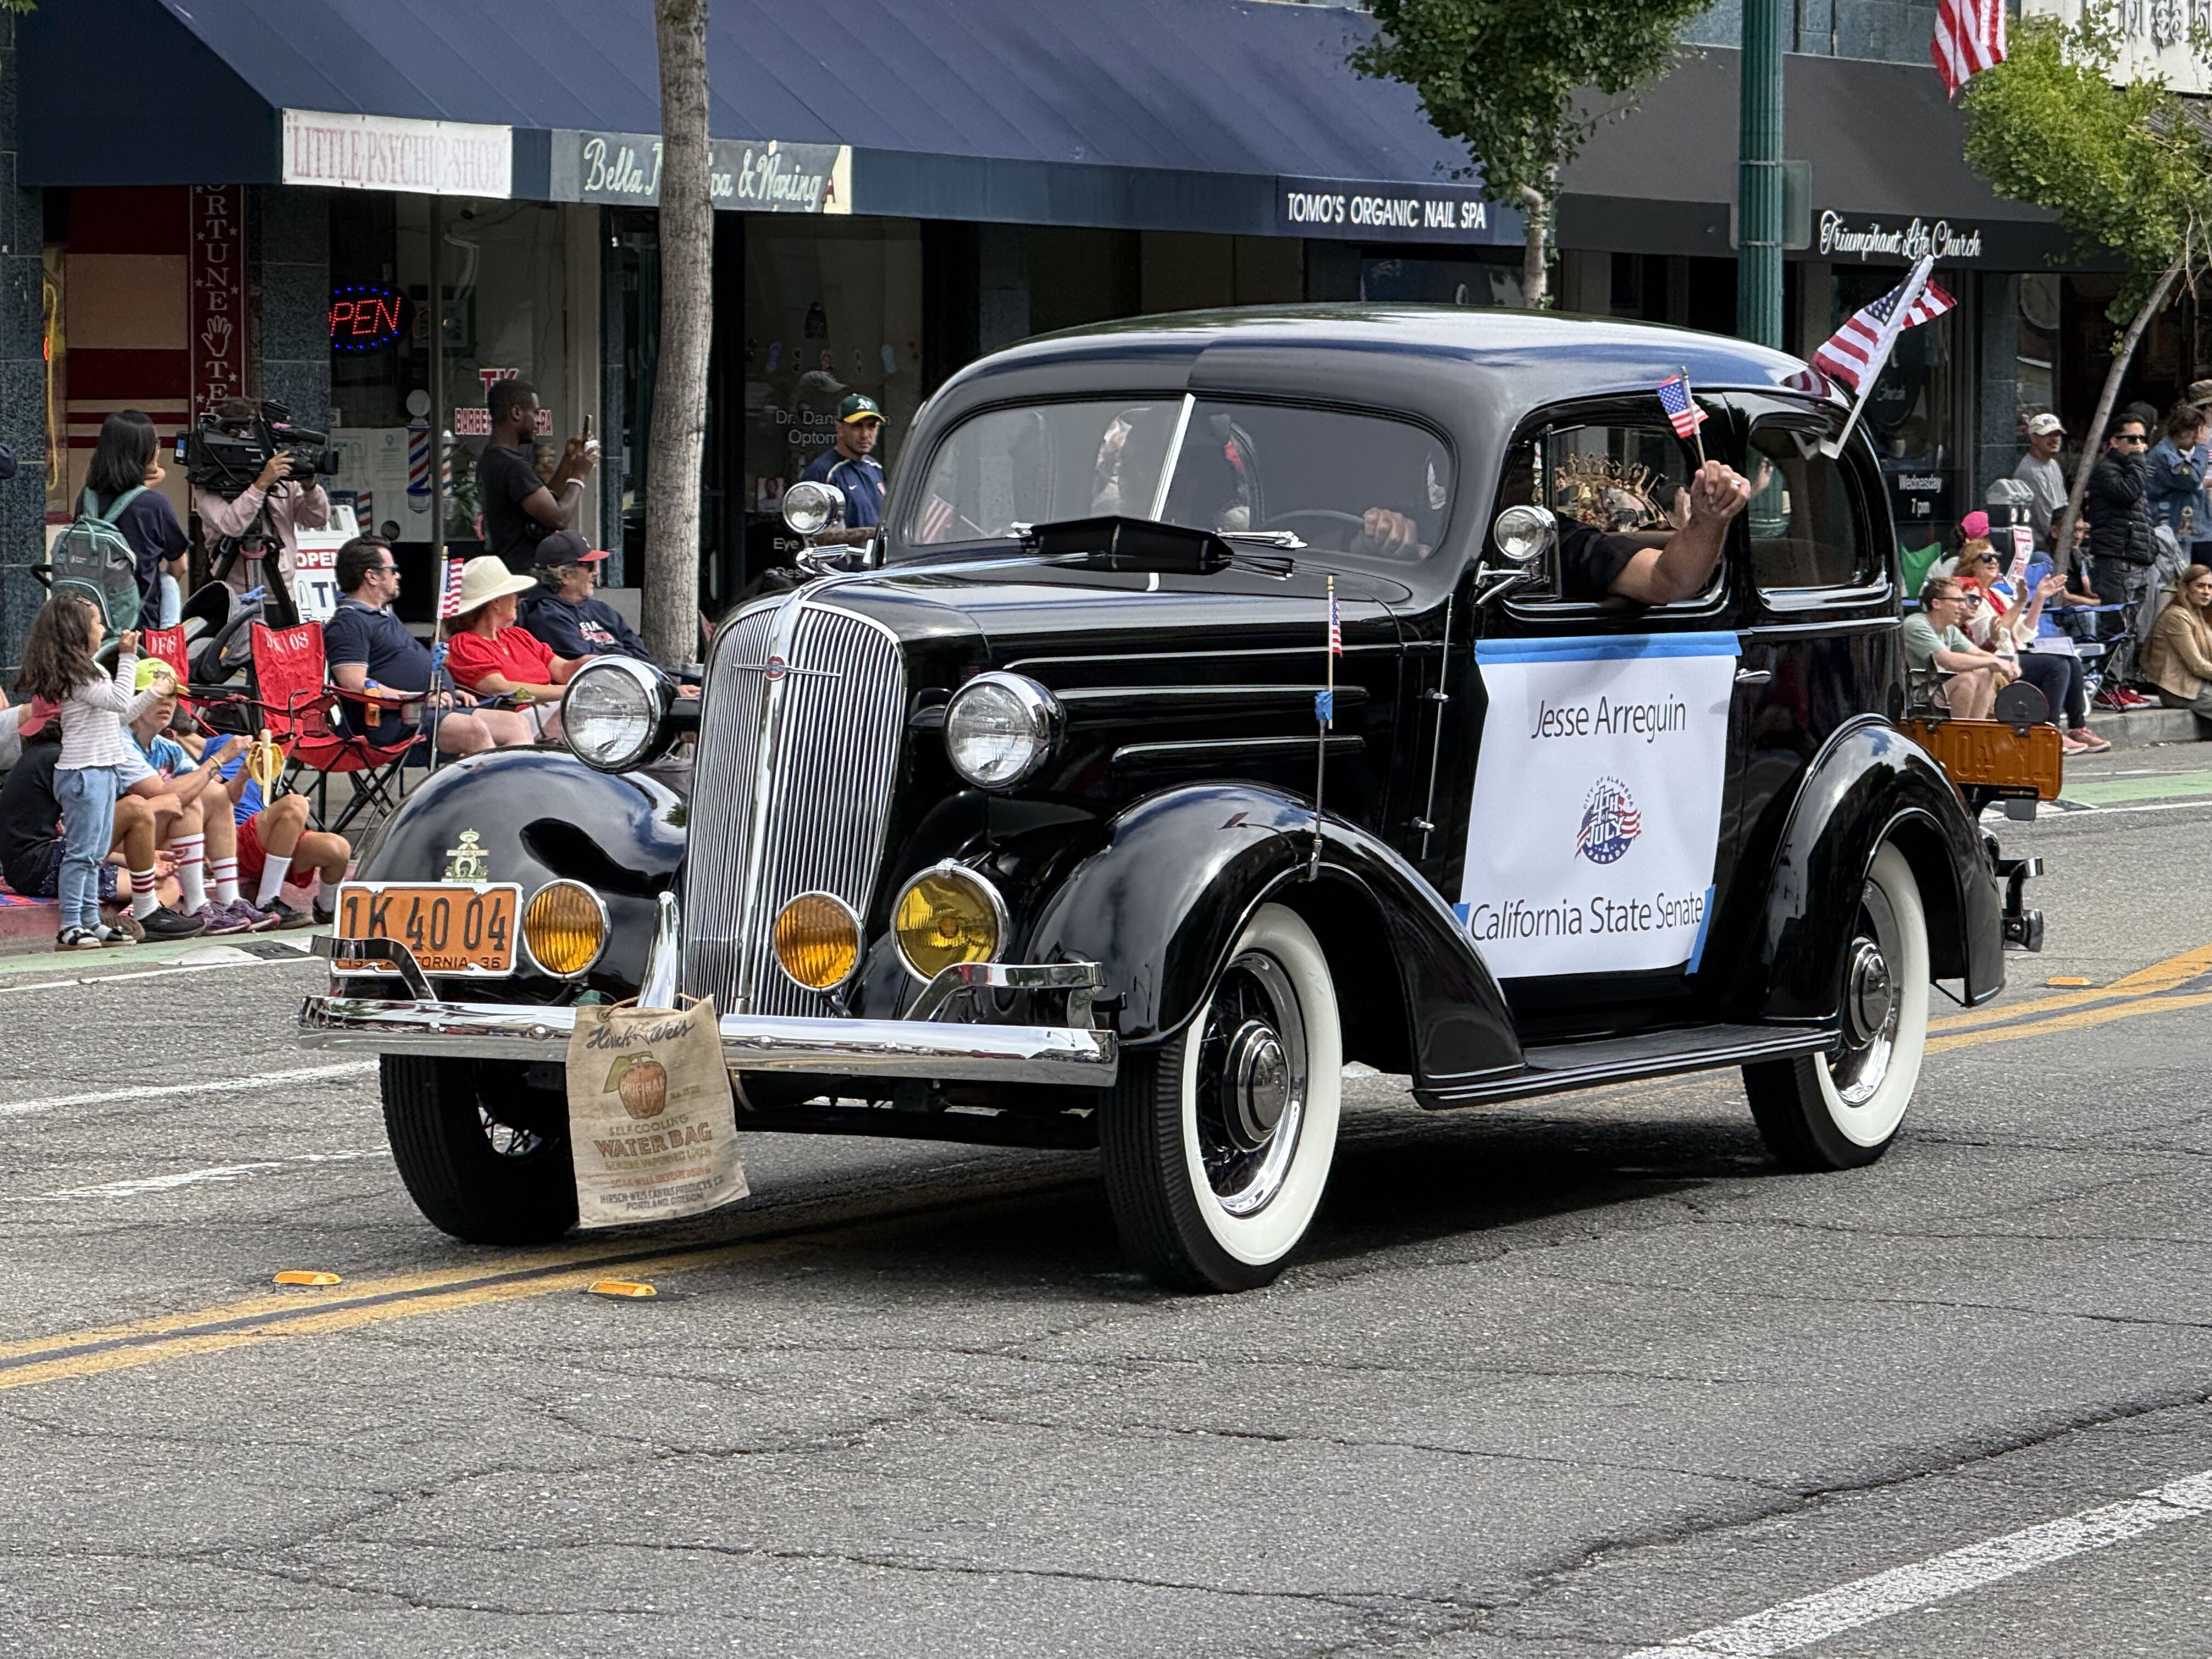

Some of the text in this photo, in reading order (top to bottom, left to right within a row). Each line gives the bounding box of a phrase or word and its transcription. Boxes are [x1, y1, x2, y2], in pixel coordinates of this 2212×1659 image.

[584, 138, 644, 191] Bella
[738, 149, 755, 198] &
[757, 154, 822, 212] Waxing
[1287, 193, 1487, 229] TOMO'S ORGANIC NAIL SPA
[204, 184, 229, 312] RTUNE
[1819, 210, 1982, 262] Triumphant Life Church
[328, 296, 402, 337] PEN
[776, 410, 795, 425] Dr.
[1898, 474, 1942, 493] Wednesday
[1911, 498, 1930, 517] 7 pm
[774, 537, 799, 551] Eye
[1531, 693, 1686, 744] Jesse Arreguin
[1606, 775, 1634, 808] ALAMEDA
[1585, 815, 1626, 849] JULY
[1471, 890, 1703, 941] California State Senate
[480, 956, 501, 968] 36
[620, 1076, 665, 1094] ORIGINAL
[593, 1122, 713, 1158] WATER BAG
[609, 1114, 689, 1136] SELF COOLING
